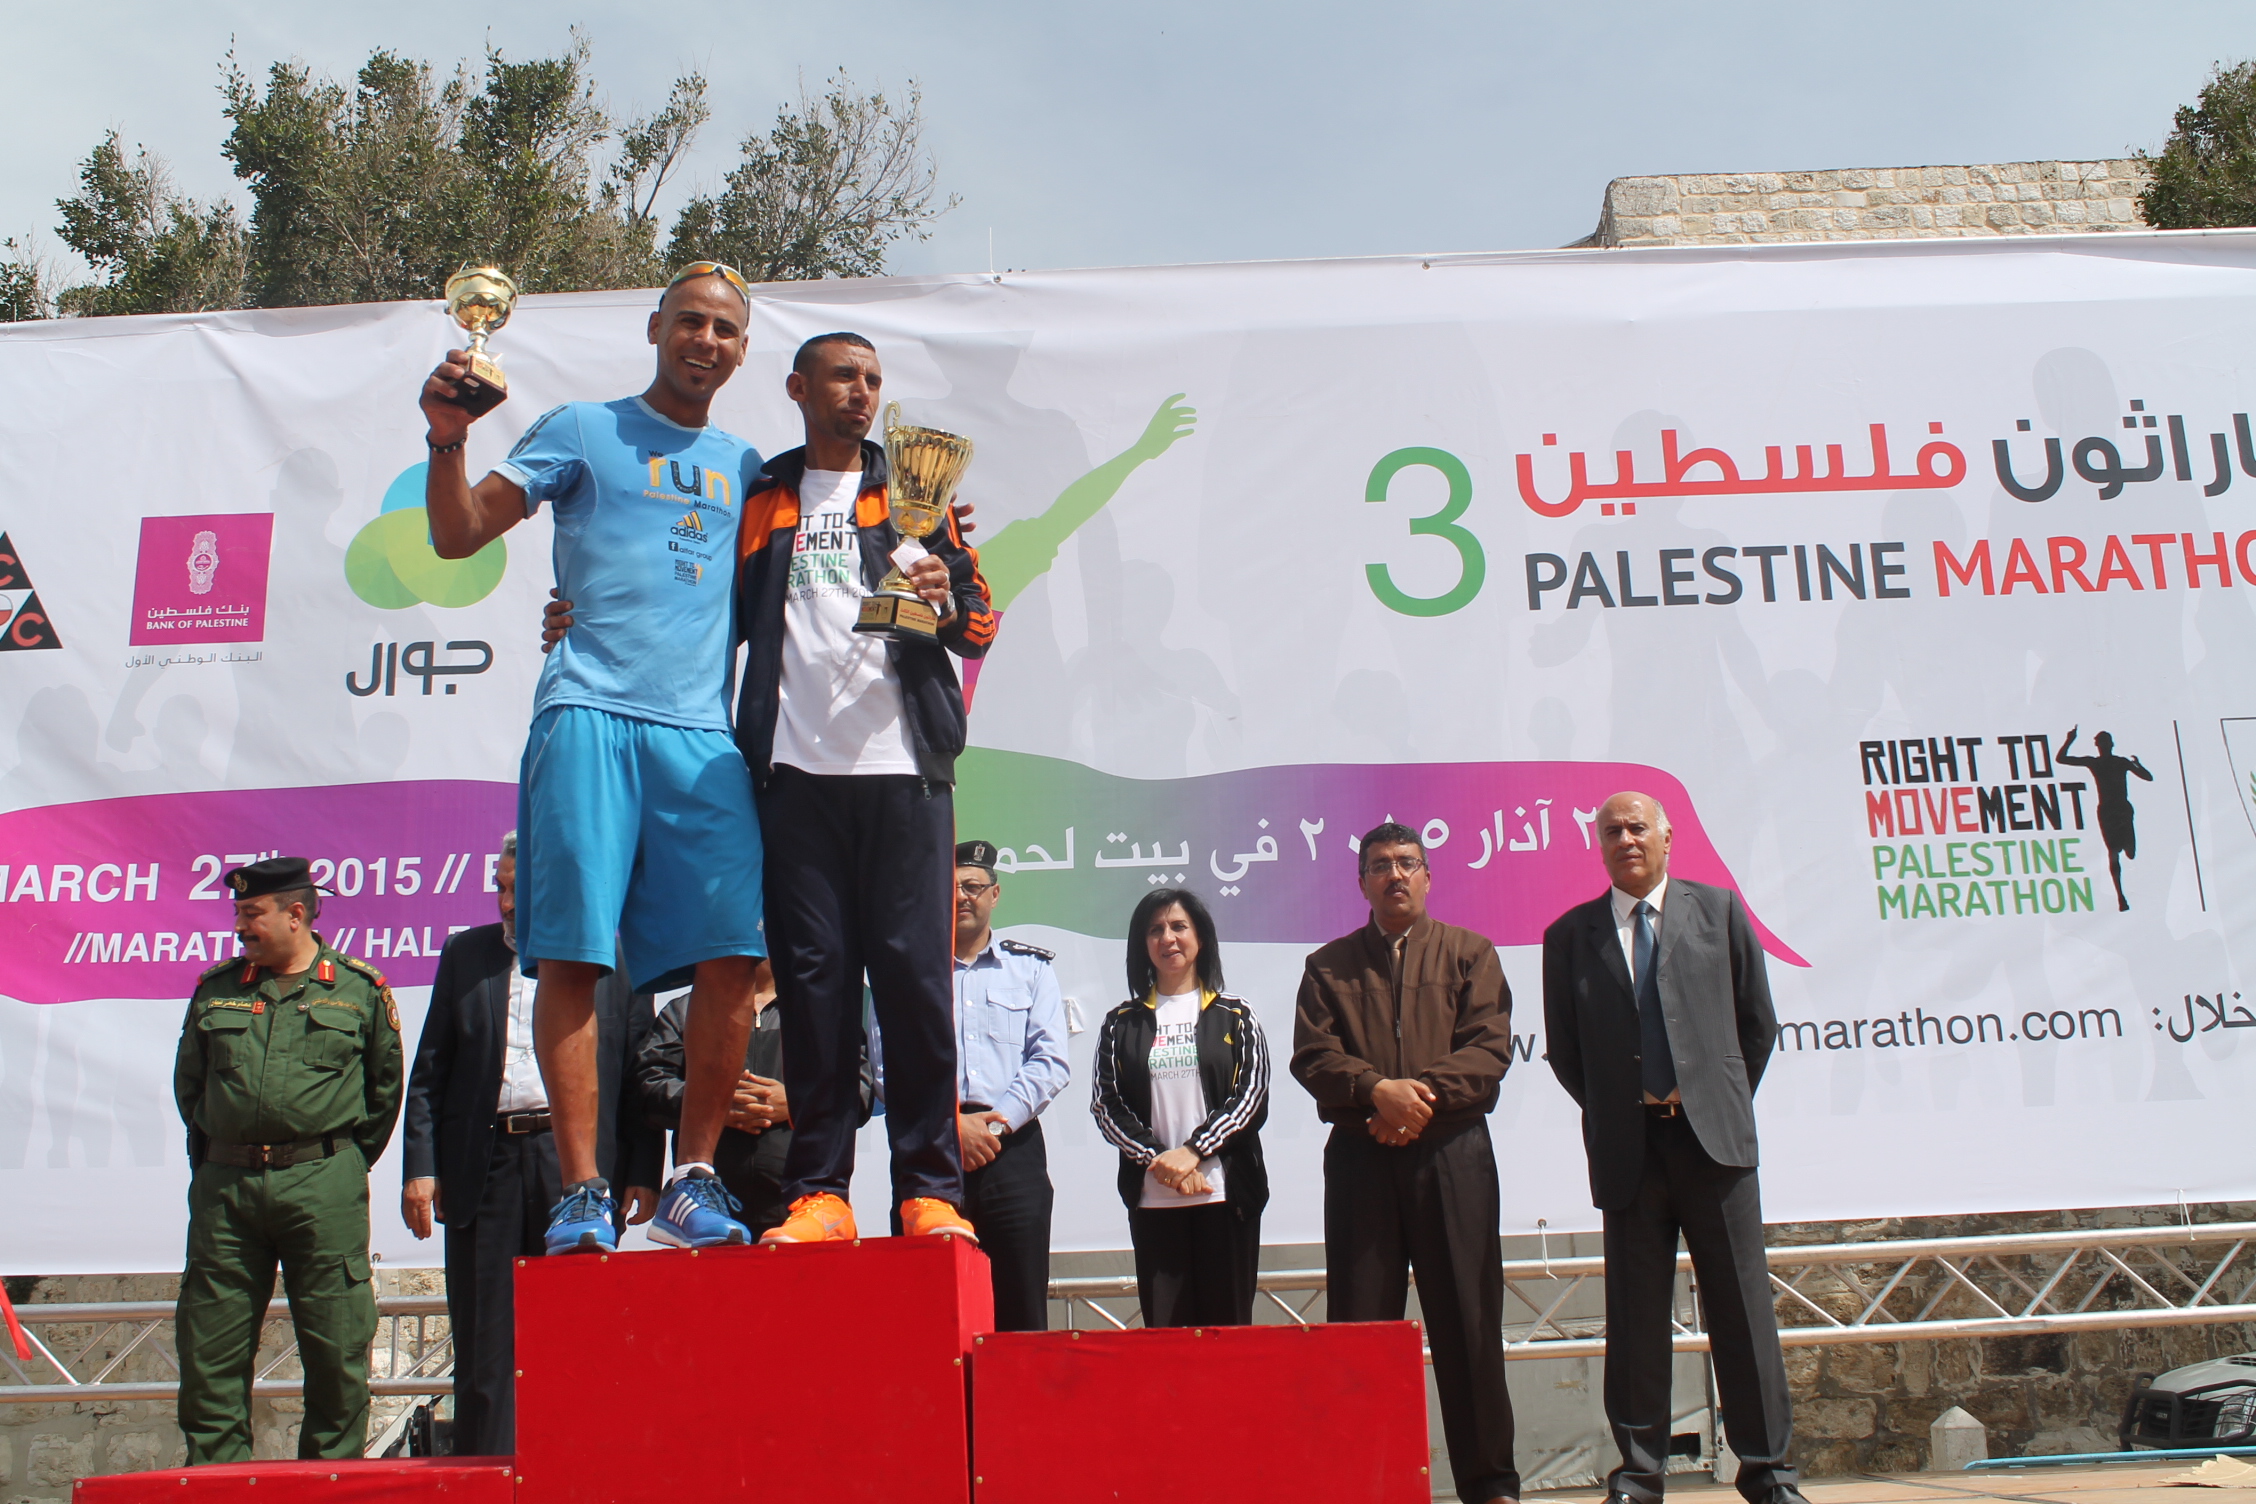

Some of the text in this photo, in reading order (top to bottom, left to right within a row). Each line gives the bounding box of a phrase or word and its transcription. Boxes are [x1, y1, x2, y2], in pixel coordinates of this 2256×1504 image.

[1515, 398, 2256, 518] اراثون فلسطين
[648, 456, 731, 507] run
[643, 489, 732, 519] Palestine Marathon
[821, 512, 844, 529] TO
[670, 526, 708, 543] adidas
[796, 531, 857, 552] EMENT
[1365, 446, 1486, 617] 3
[788, 569, 850, 588] RATHON
[791, 553, 849, 571] ESTINE
[1524, 541, 1911, 611] PALESTINE
[147, 604, 250, 619] بنك فلسطين
[785, 588, 818, 603] MARCH
[821, 587, 849, 598] 27TH
[146, 618, 249, 630] BANK OF PALESTINE
[125, 651, 263, 670] البنك الوطني الأول
[346, 640, 494, 697] جوال
[1859, 734, 2054, 785] RIGHT TO
[1865, 782, 2087, 838] MOVEMENT
[1467, 798, 1553, 870] آذار
[1094, 832, 1190, 885] بيت
[1210, 818, 1278, 897] في
[1872, 838, 2085, 880] PALESTINE
[0, 863, 160, 902] ARCH
[309, 857, 422, 898] 2015
[1877, 877, 2095, 920] MARATHON
[1152, 1033, 1194, 1047] VEMEN
[1176, 1022, 1192, 1034] TO
[1150, 1045, 1198, 1057] ESTINE
